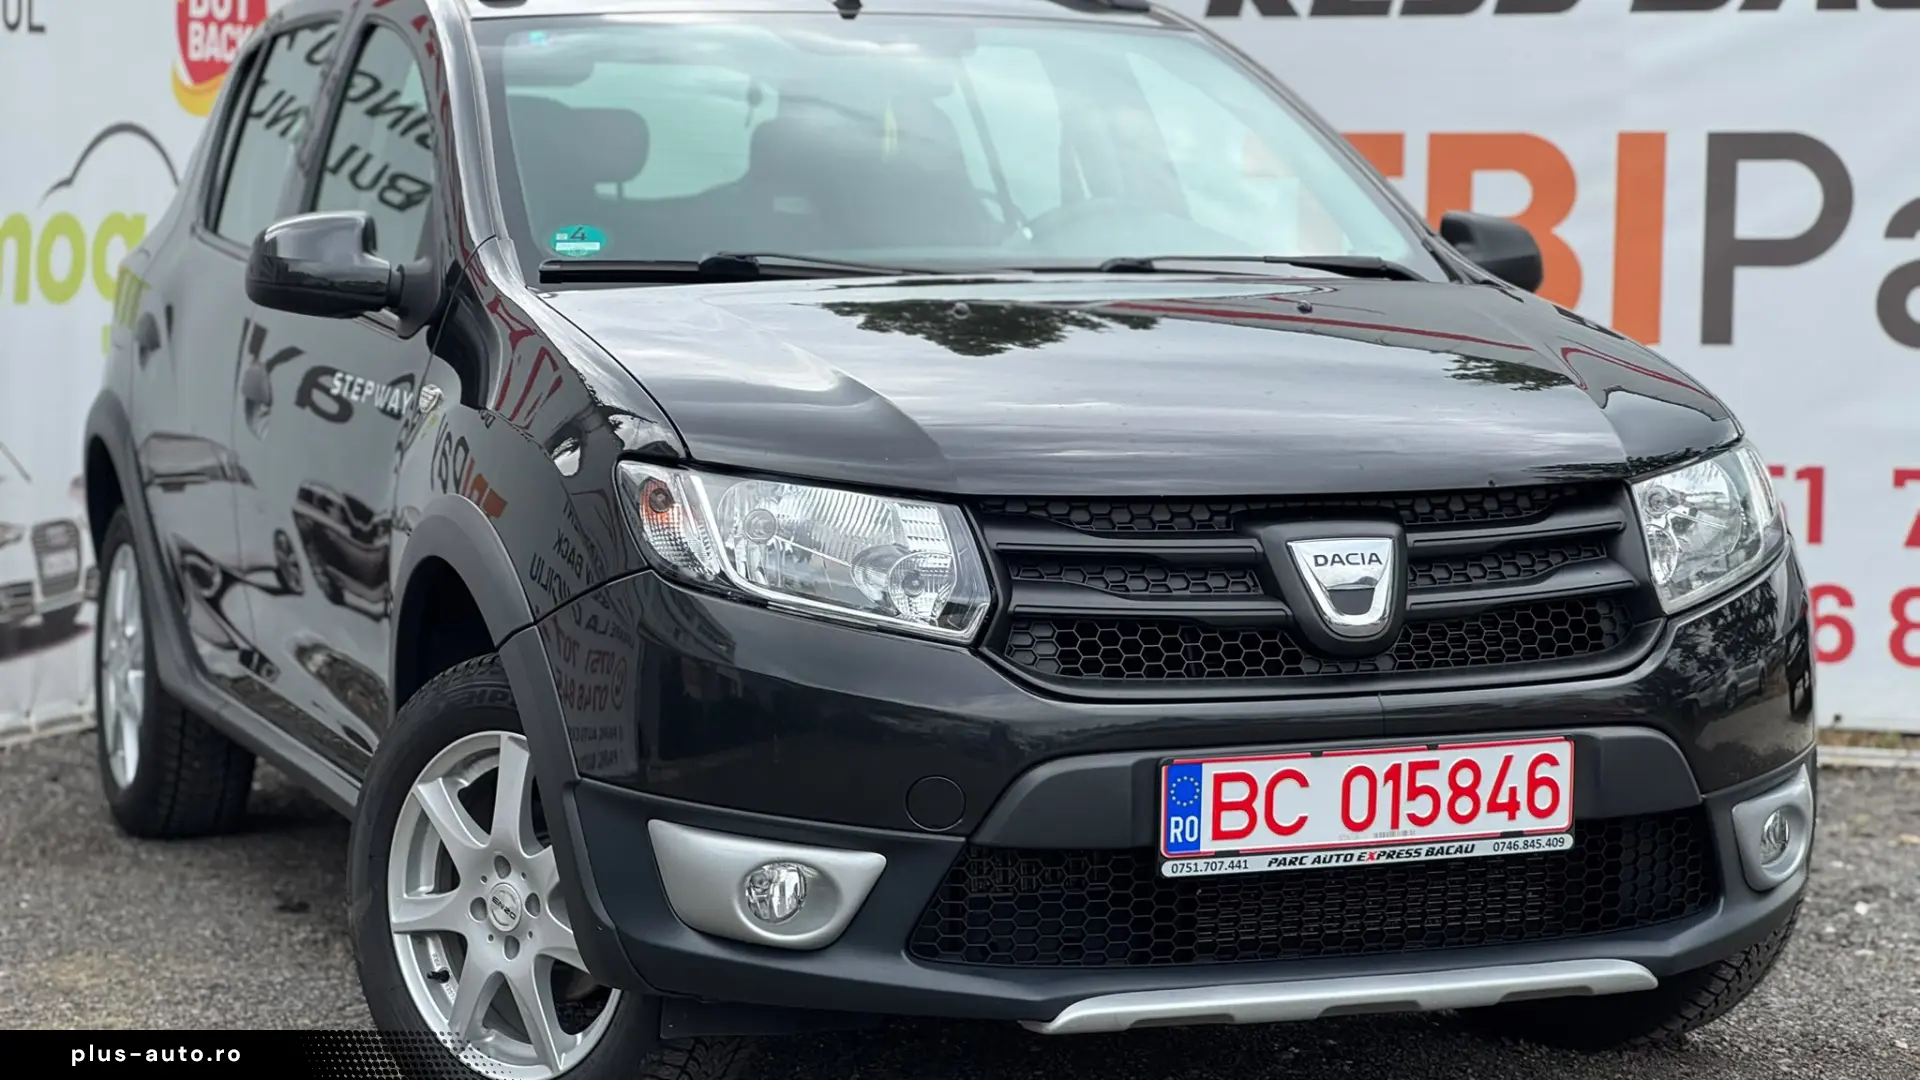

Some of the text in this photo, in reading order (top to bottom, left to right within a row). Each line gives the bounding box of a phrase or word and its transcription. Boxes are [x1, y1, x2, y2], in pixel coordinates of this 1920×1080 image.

[329, 371, 414, 415] STEPWAY
[1313, 552, 1383, 567] DACIA
[1211, 752, 1561, 842] BC 015846
[1169, 814, 1199, 844] RO
[1171, 836, 1566, 874] 0751.707.441 PARC AUTO EXPRESS BACAU 0746.845.409
[492, 896, 517, 920] ENZO
